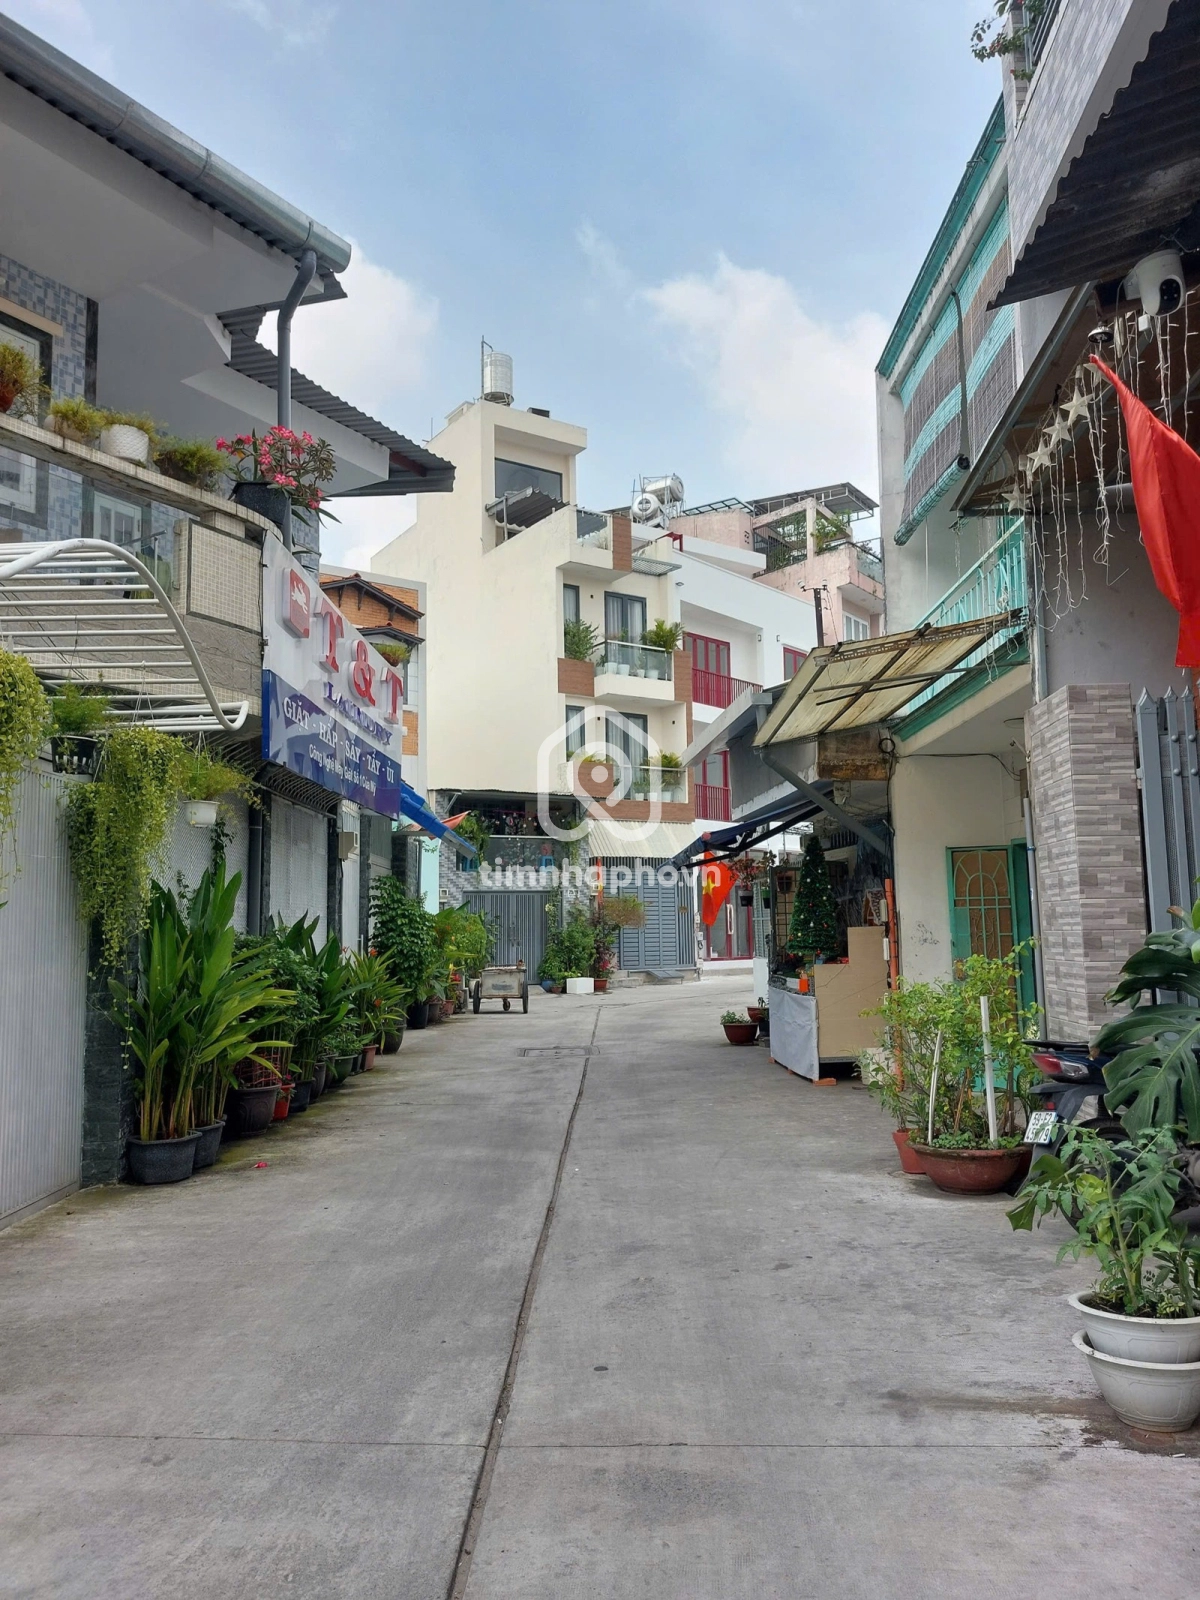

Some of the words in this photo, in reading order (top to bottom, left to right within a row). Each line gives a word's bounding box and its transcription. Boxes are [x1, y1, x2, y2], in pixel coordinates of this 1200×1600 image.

[314, 597, 344, 674] T
[350, 639, 376, 707] &
[381, 667, 404, 725] T
[283, 697, 310, 732] GIẶT
[309, 744, 323, 767] Công
